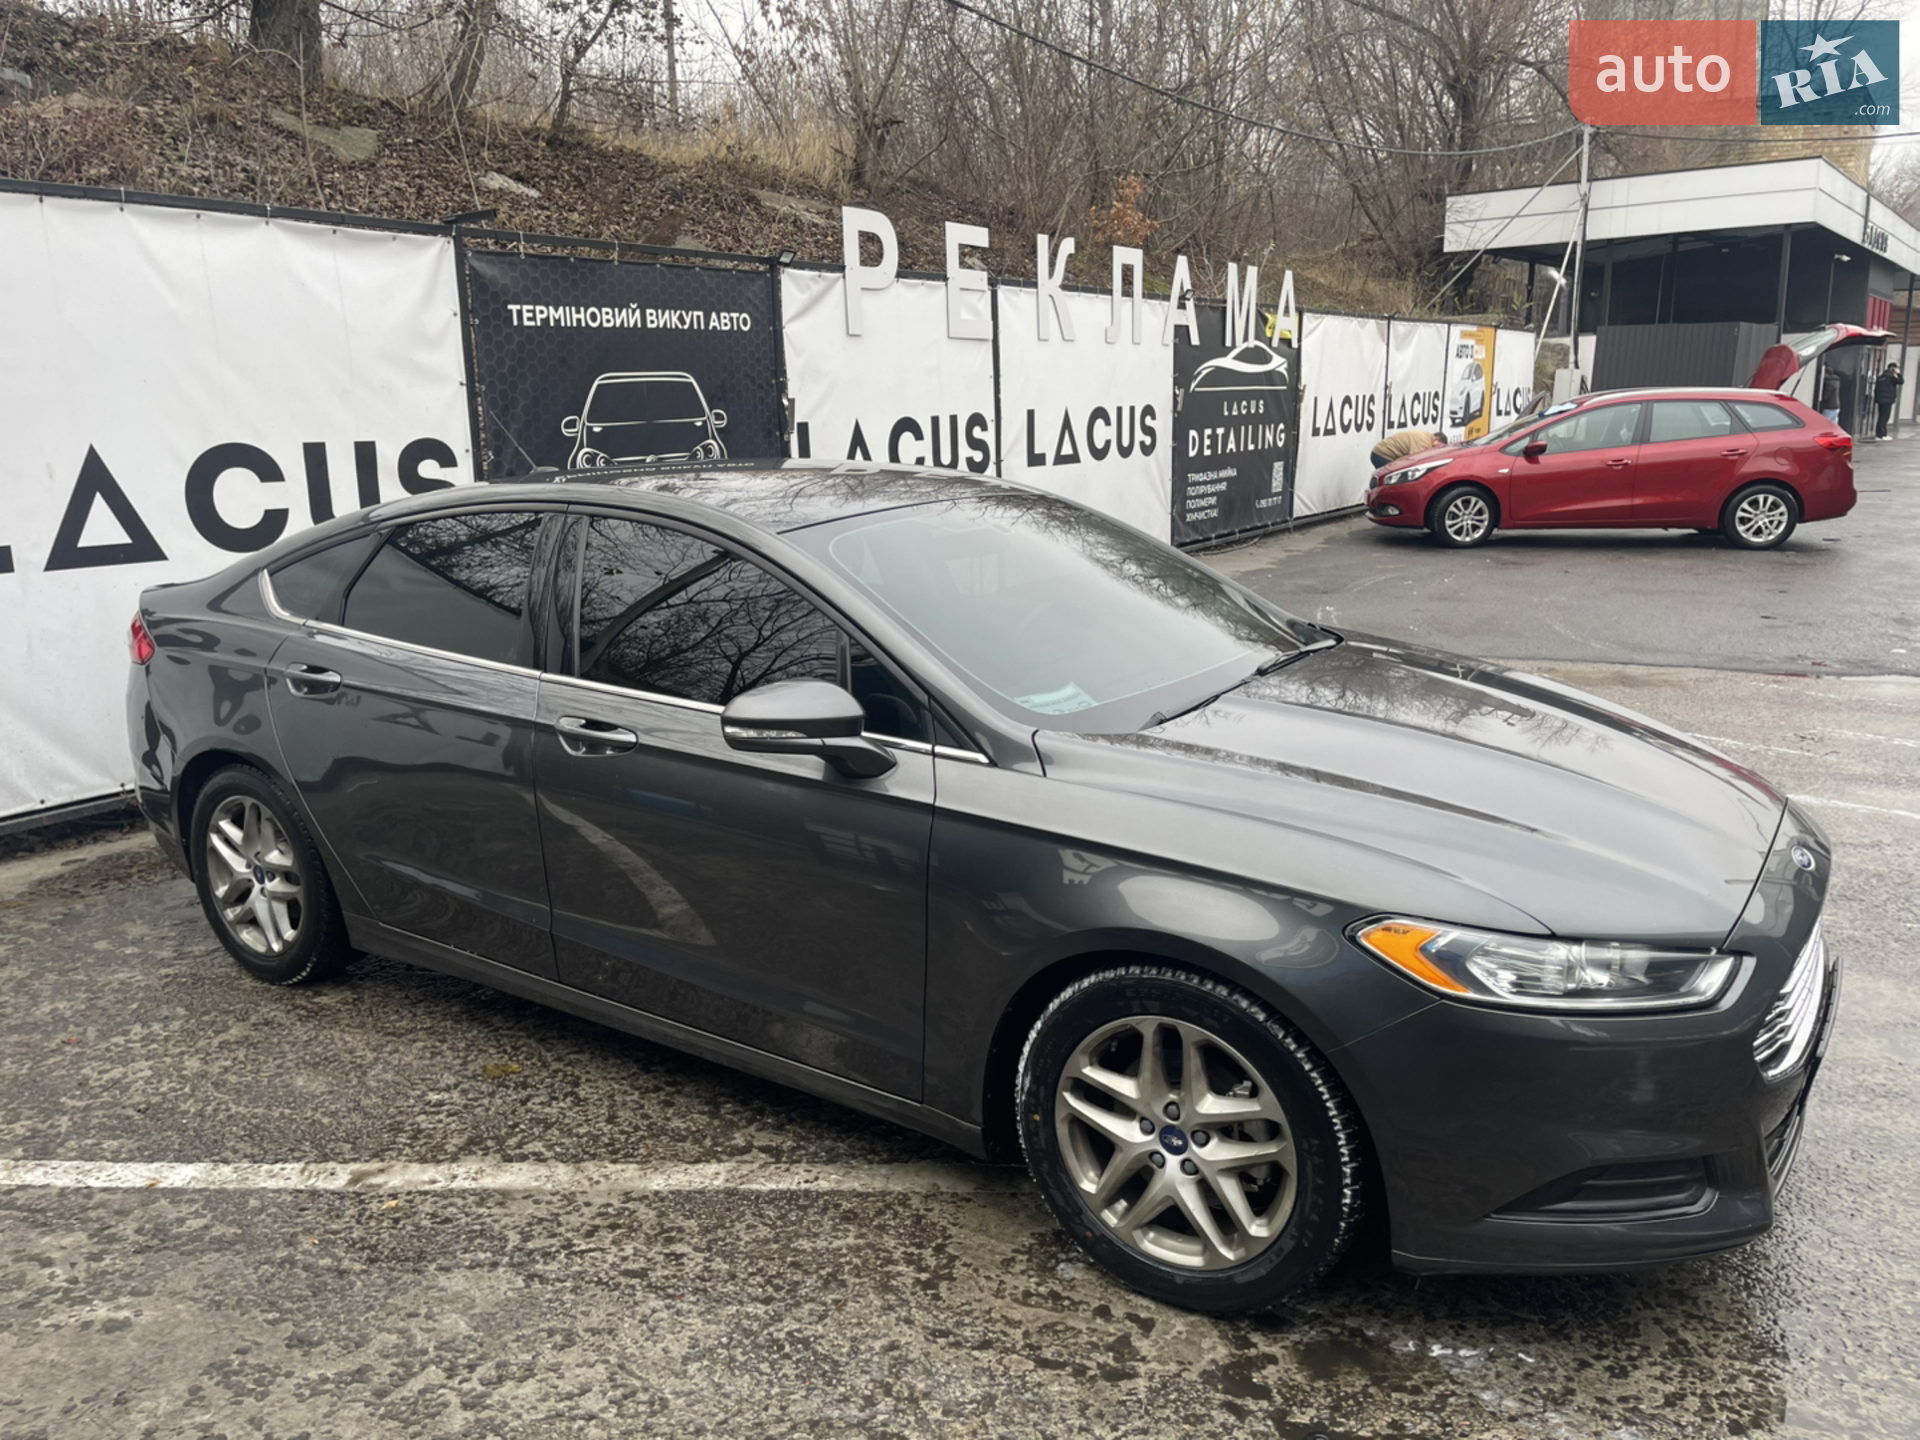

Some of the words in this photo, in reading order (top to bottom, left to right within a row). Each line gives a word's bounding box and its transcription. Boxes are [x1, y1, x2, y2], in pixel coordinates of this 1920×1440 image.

[842, 206, 1298, 348] РЕКЛАМА
[507, 302, 642, 328] ТЕРМІНОВИЙ
[645, 309, 704, 330] ВИКУП
[708, 312, 751, 331] АВТО
[1224, 400, 1264, 416] LACUS
[1311, 393, 1375, 437] LACUS
[1387, 390, 1440, 430] LACUS
[1027, 404, 1157, 468] LACUS
[1188, 422, 1286, 458] DETAILING
[0, 437, 458, 574] ACUS
